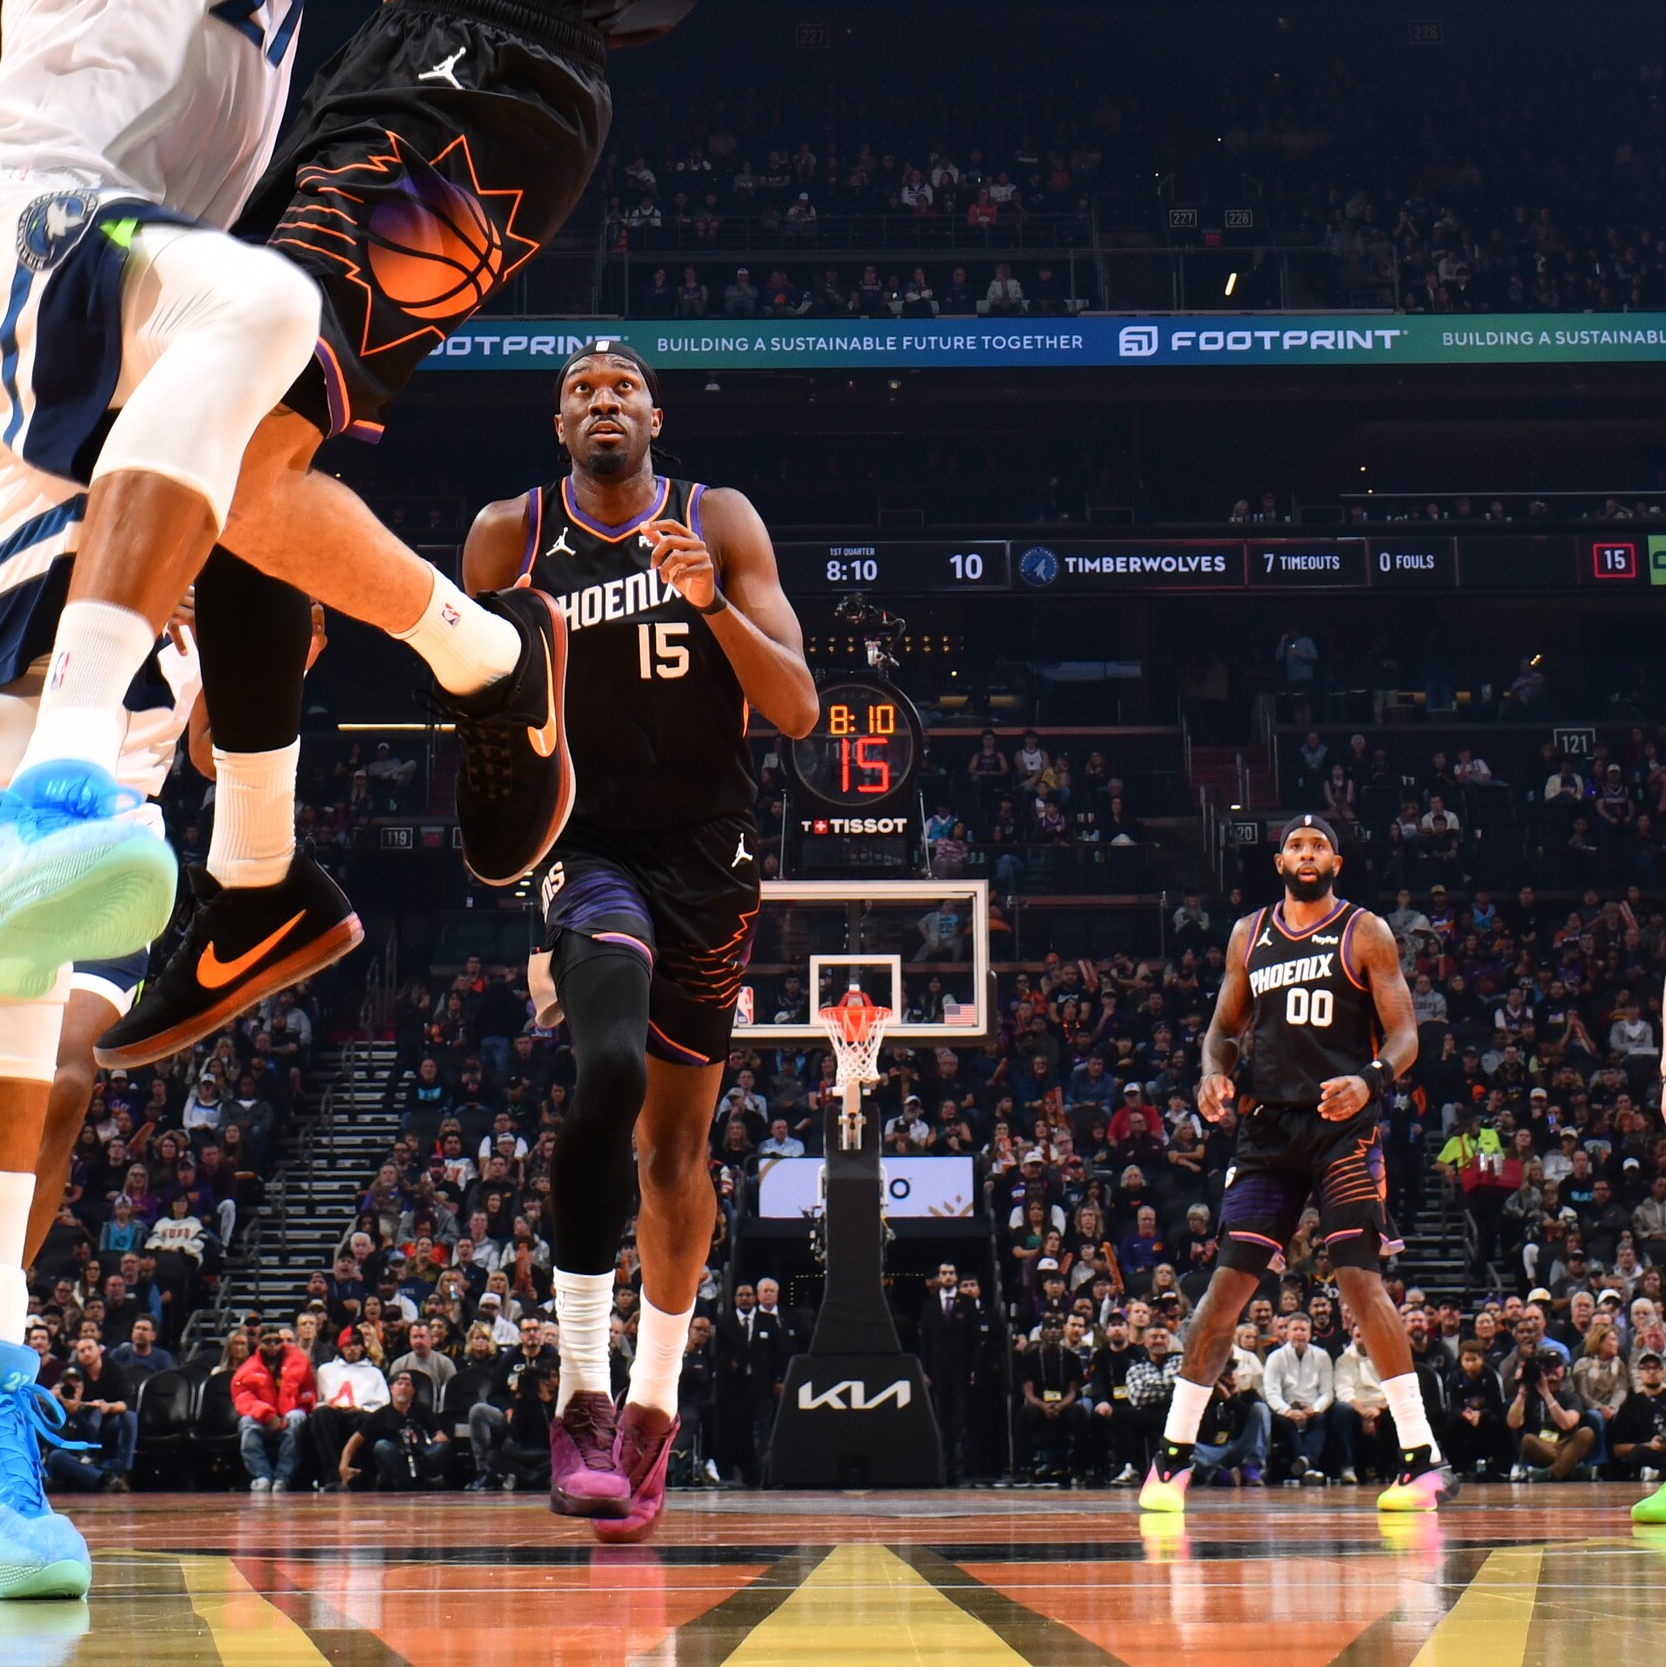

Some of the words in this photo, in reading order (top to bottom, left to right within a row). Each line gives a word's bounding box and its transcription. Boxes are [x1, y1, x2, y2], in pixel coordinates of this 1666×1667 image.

[1173, 213, 1193, 224] 227
[658, 338, 750, 353] BUILDING
[754, 337, 766, 352] A
[771, 336, 897, 352] SUSTAINABLE
[903, 336, 977, 351] FUTURE
[982, 335, 1083, 350] TOGETHER
[1171, 329, 1401, 351] FOOTPRINT
[1442, 331, 1534, 347] BUILDING
[1538, 331, 1551, 346] A
[843, 547, 875, 555] QUARTER
[1604, 549, 1625, 570] 15
[826, 559, 877, 581] 8:10
[949, 554, 983, 579] 10
[1065, 556, 1226, 573] TIMBERWOLVES
[1264, 553, 1275, 573] 7
[1280, 555, 1340, 571] TIMEOUTS
[1379, 552, 1390, 571] 0
[1396, 553, 1434, 569] FOULS
[638, 623, 689, 680] 15
[830, 705, 894, 735] 8:10
[1562, 735, 1587, 753] 121
[842, 736, 890, 794] 15
[830, 818, 907, 835] TISSOT
[1311, 934, 1339, 945] PayPal
[1249, 953, 1334, 997] PHOENIX
[1286, 988, 1334, 1027] 00
[798, 1380, 912, 1410] KIA
